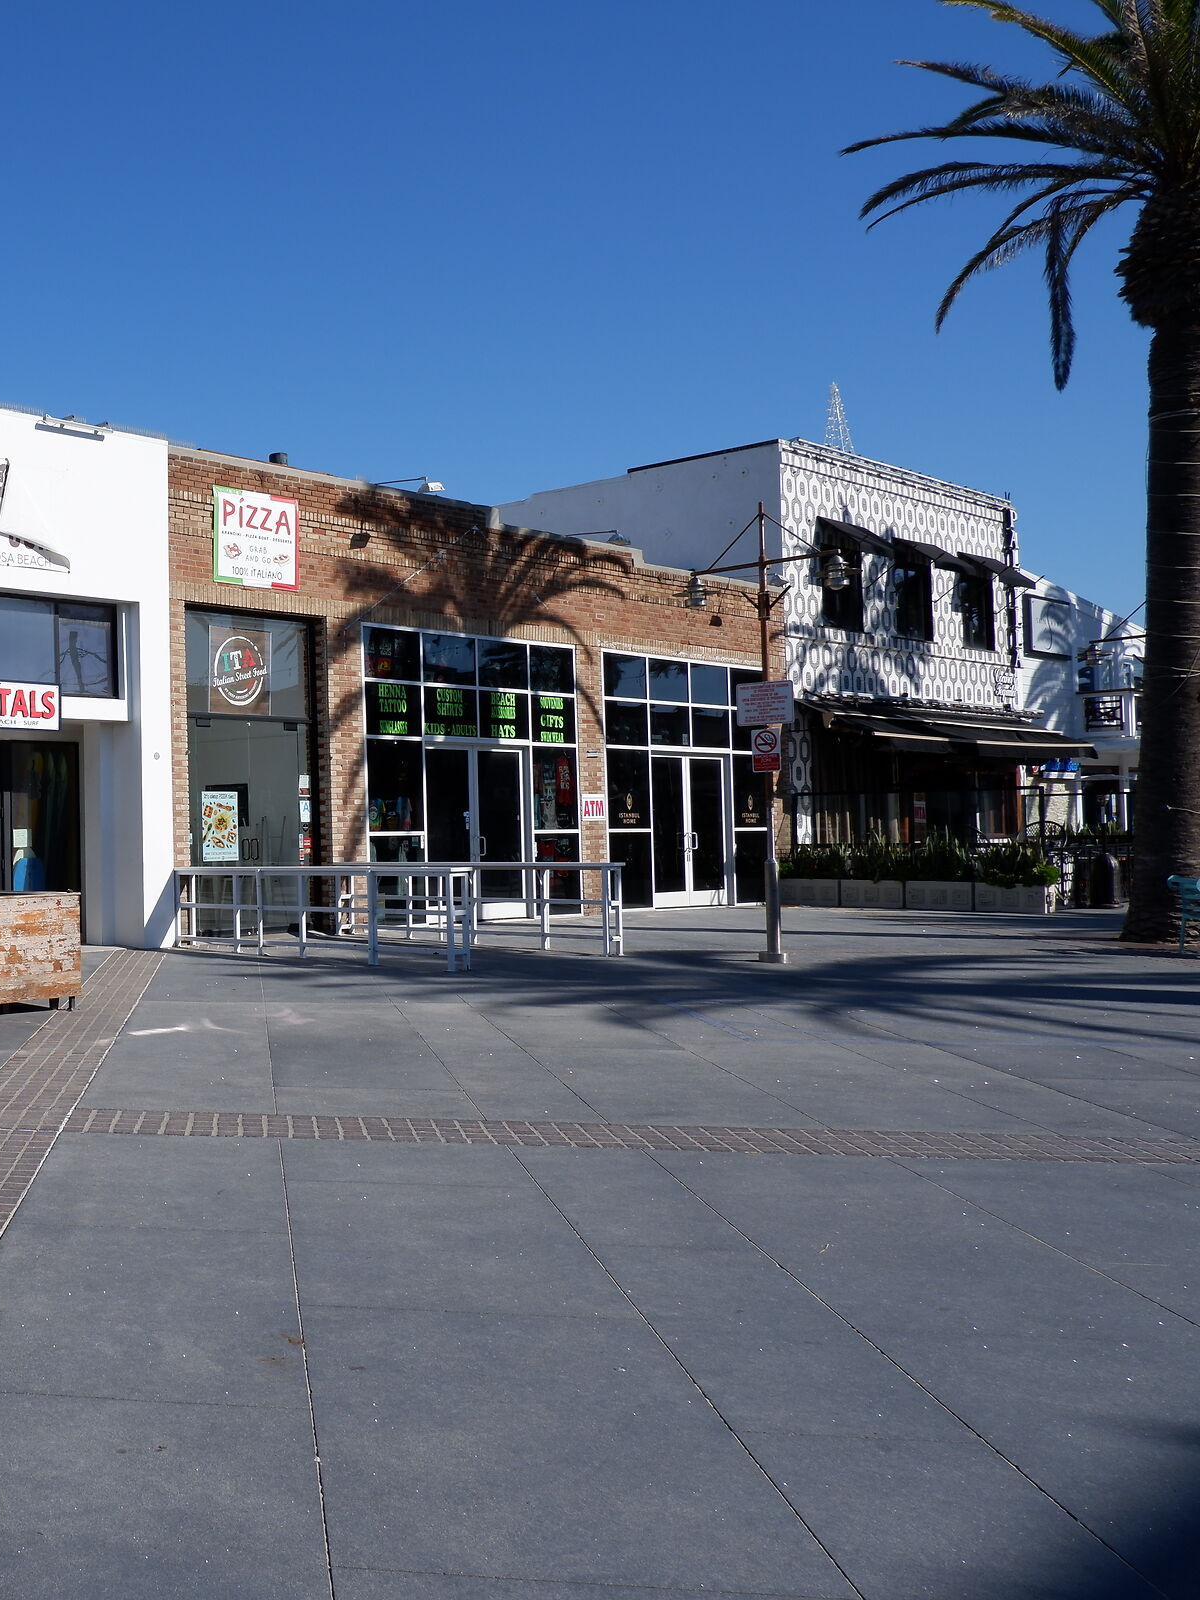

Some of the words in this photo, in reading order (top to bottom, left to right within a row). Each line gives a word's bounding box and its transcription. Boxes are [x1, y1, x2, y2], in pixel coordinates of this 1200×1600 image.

[249, 545, 268, 555] GRAB
[17, 553, 52, 567] BEACH
[245, 554, 259, 564] AND
[261, 556, 272, 564] GO
[232, 565, 249, 577] 100%
[221, 648, 257, 672] ITA
[212, 675, 235, 687] Italian
[235, 671, 252, 681] Street
[252, 665, 268, 678] Food
[378, 684, 407, 699] HENNA
[436, 688, 463, 703] CUSTOM
[379, 699, 407, 713] TATTOO
[490, 692, 516, 706] BEACH
[436, 702, 463, 716] SHIRTS
[379, 720, 408, 735] SUNGLASSES
[540, 714, 564, 728] GIFTS
[424, 722, 445, 735] KIDS
[490, 724, 516, 738] HATS
[583, 800, 604, 817] ATM
